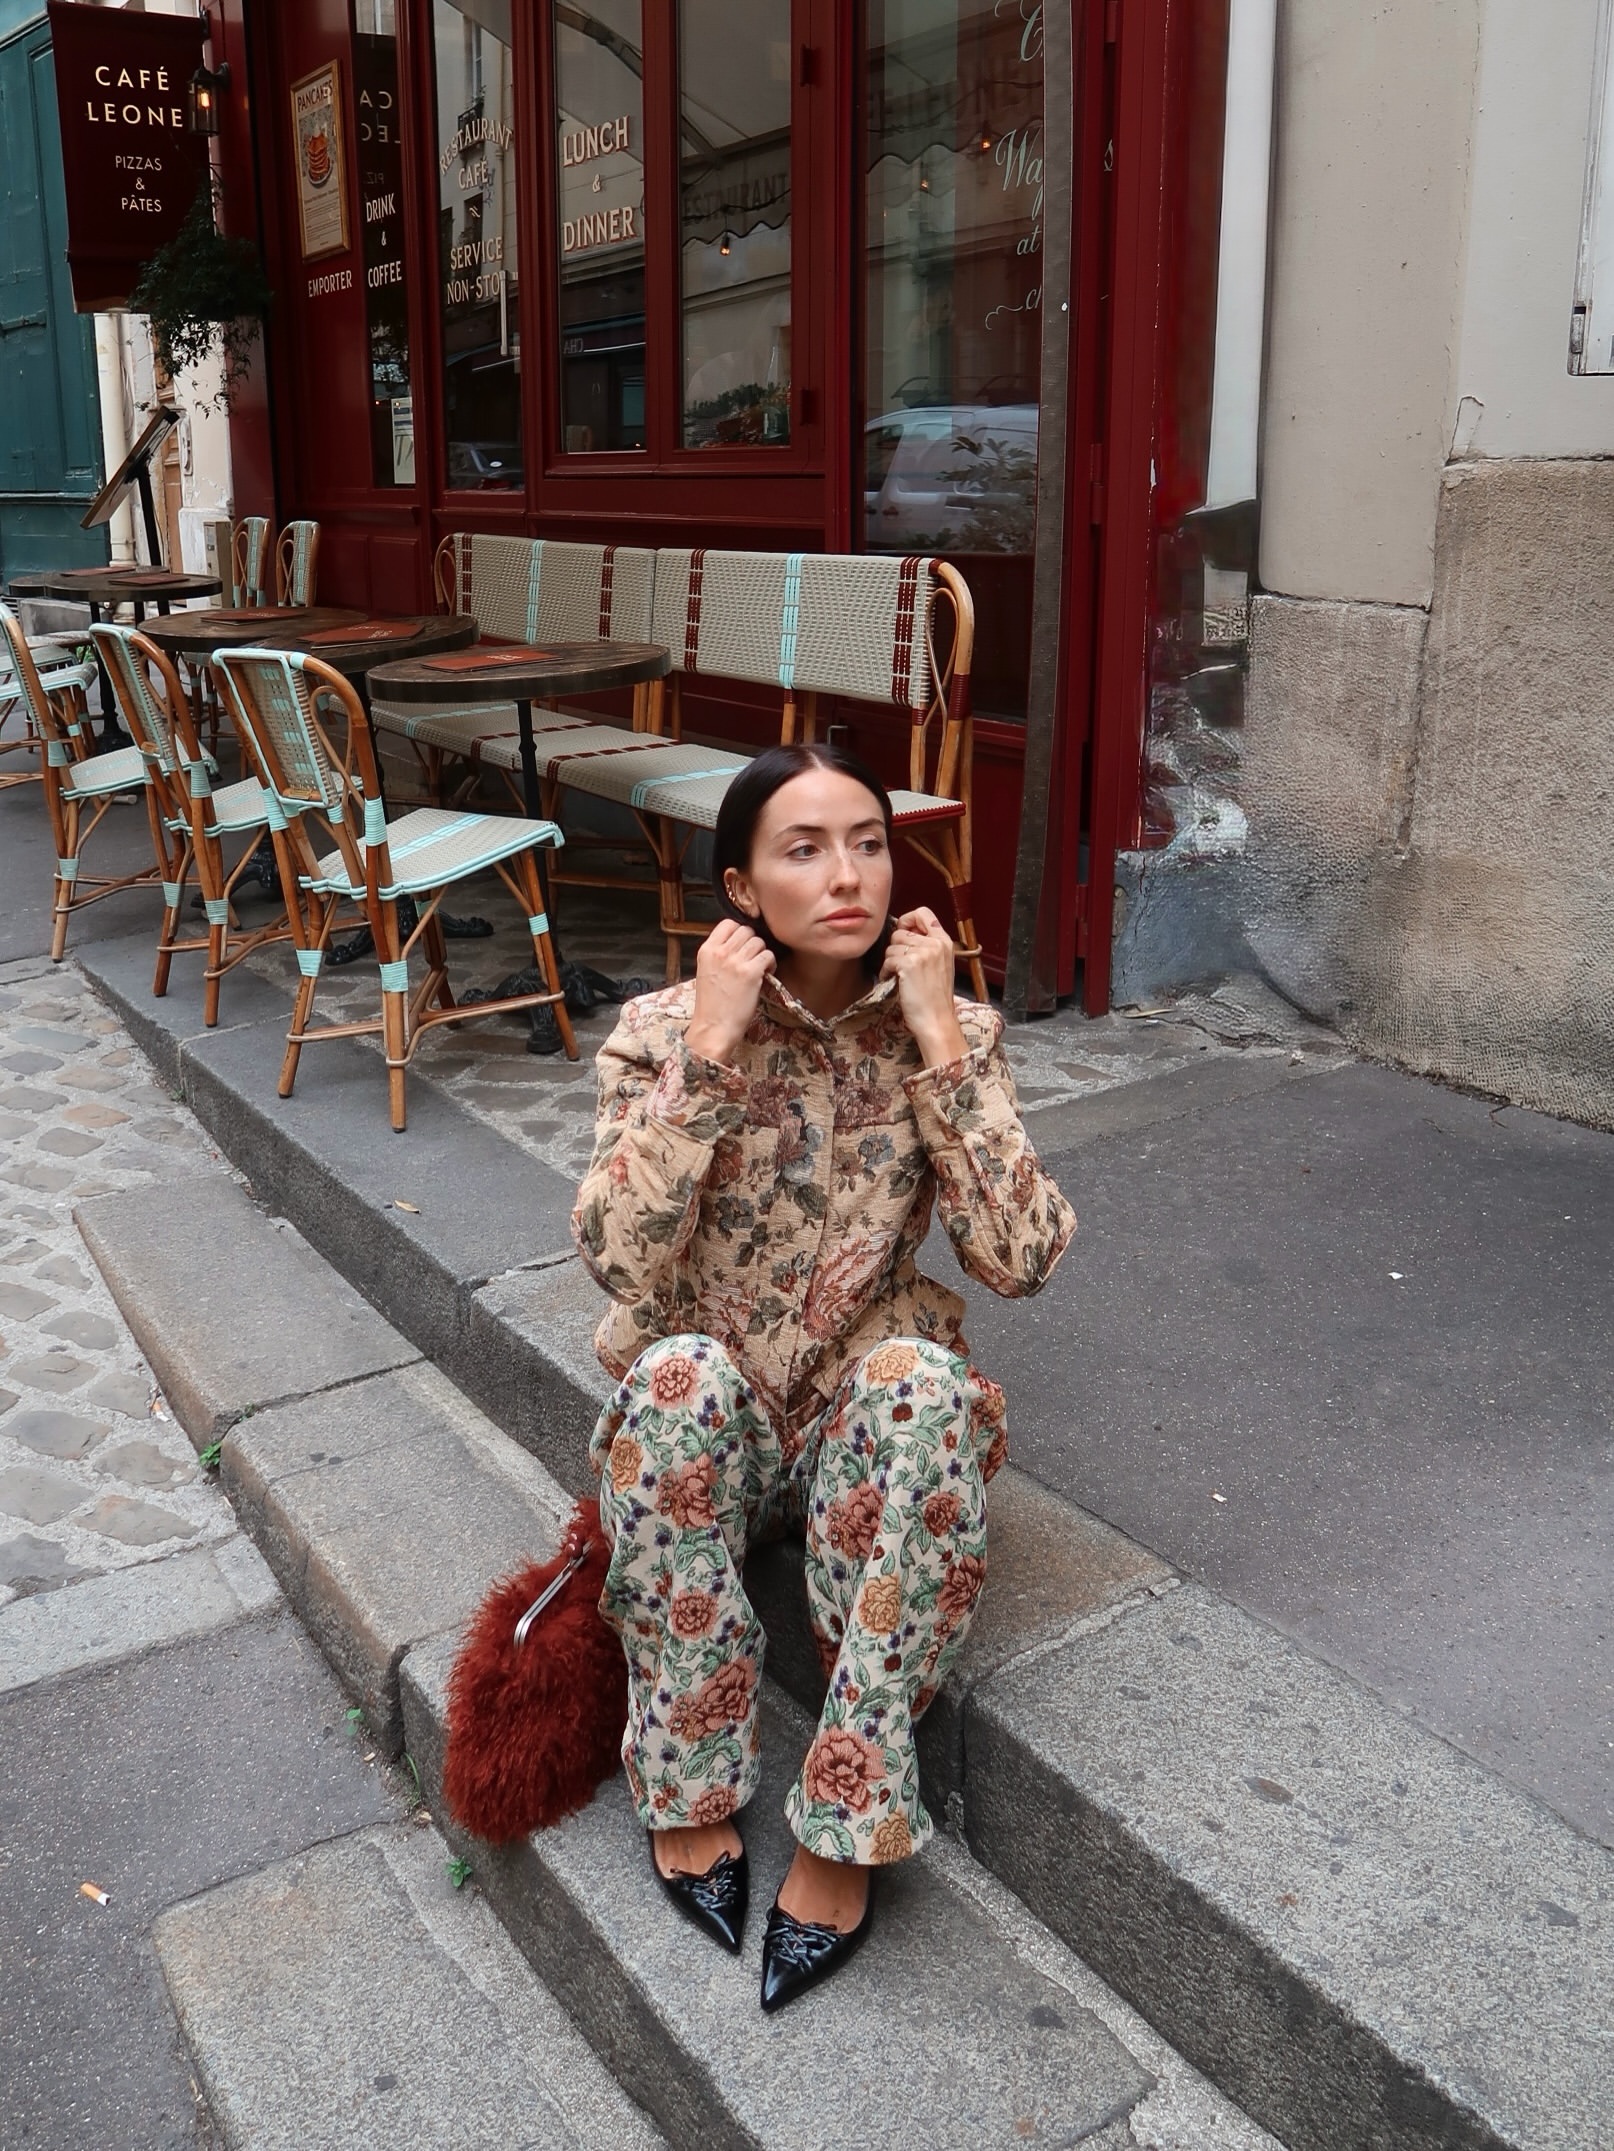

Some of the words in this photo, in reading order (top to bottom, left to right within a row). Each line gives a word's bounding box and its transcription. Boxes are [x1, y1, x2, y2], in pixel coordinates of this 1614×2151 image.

[95, 66, 170, 91] CAFÉ
[87, 102, 184, 128] LEONE
[440, 118, 514, 175] RESTAURANT
[563, 115, 629, 168] LUNCH
[115, 155, 162, 171] PIZZAS
[458, 155, 489, 190] CAFÉ
[135, 177, 145, 190] &
[592, 173, 602, 193] &
[121, 195, 162, 212] PÂTES
[366, 193, 396, 223] DRINK
[380, 231, 387, 246] &
[563, 206, 636, 253] DINNER
[450, 236, 503, 271] SERVICE
[308, 270, 352, 298] EMPORTER
[368, 260, 402, 288] COFFEE
[447, 271, 506, 305] NON-STO
